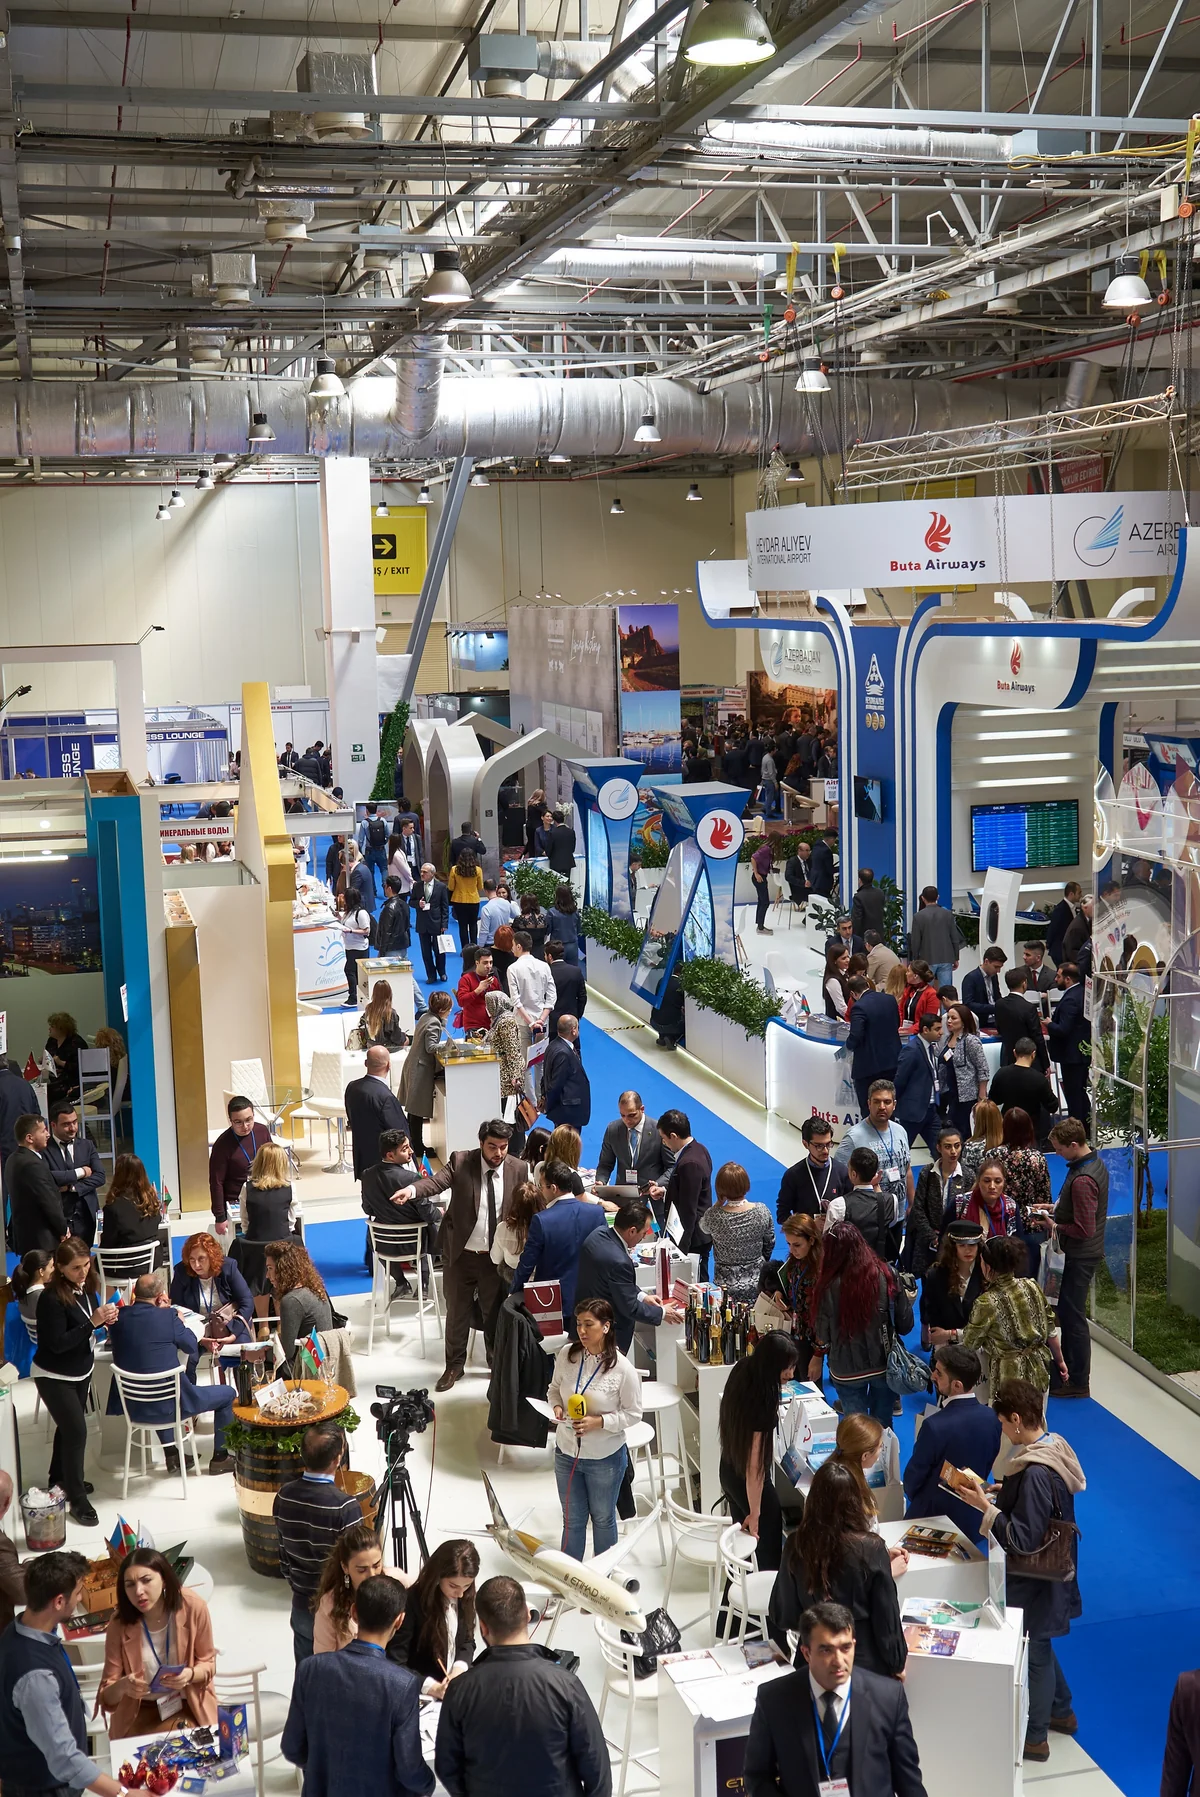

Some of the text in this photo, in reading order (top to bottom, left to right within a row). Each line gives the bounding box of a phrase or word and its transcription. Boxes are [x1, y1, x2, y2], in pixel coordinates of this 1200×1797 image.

[756, 535, 812, 553] HEYDAR ALIYEV
[756, 552, 812, 565] INTERNATIONAL AIRPORT
[890, 558, 986, 572] Buta Airways
[391, 566, 410, 575] EXIT
[997, 680, 1035, 694] Buta Airways
[165, 731, 205, 741] LOUNGE
[207, 826, 229, 836] ВОДЫ
[570, 1576, 599, 1598] ETIHAD
